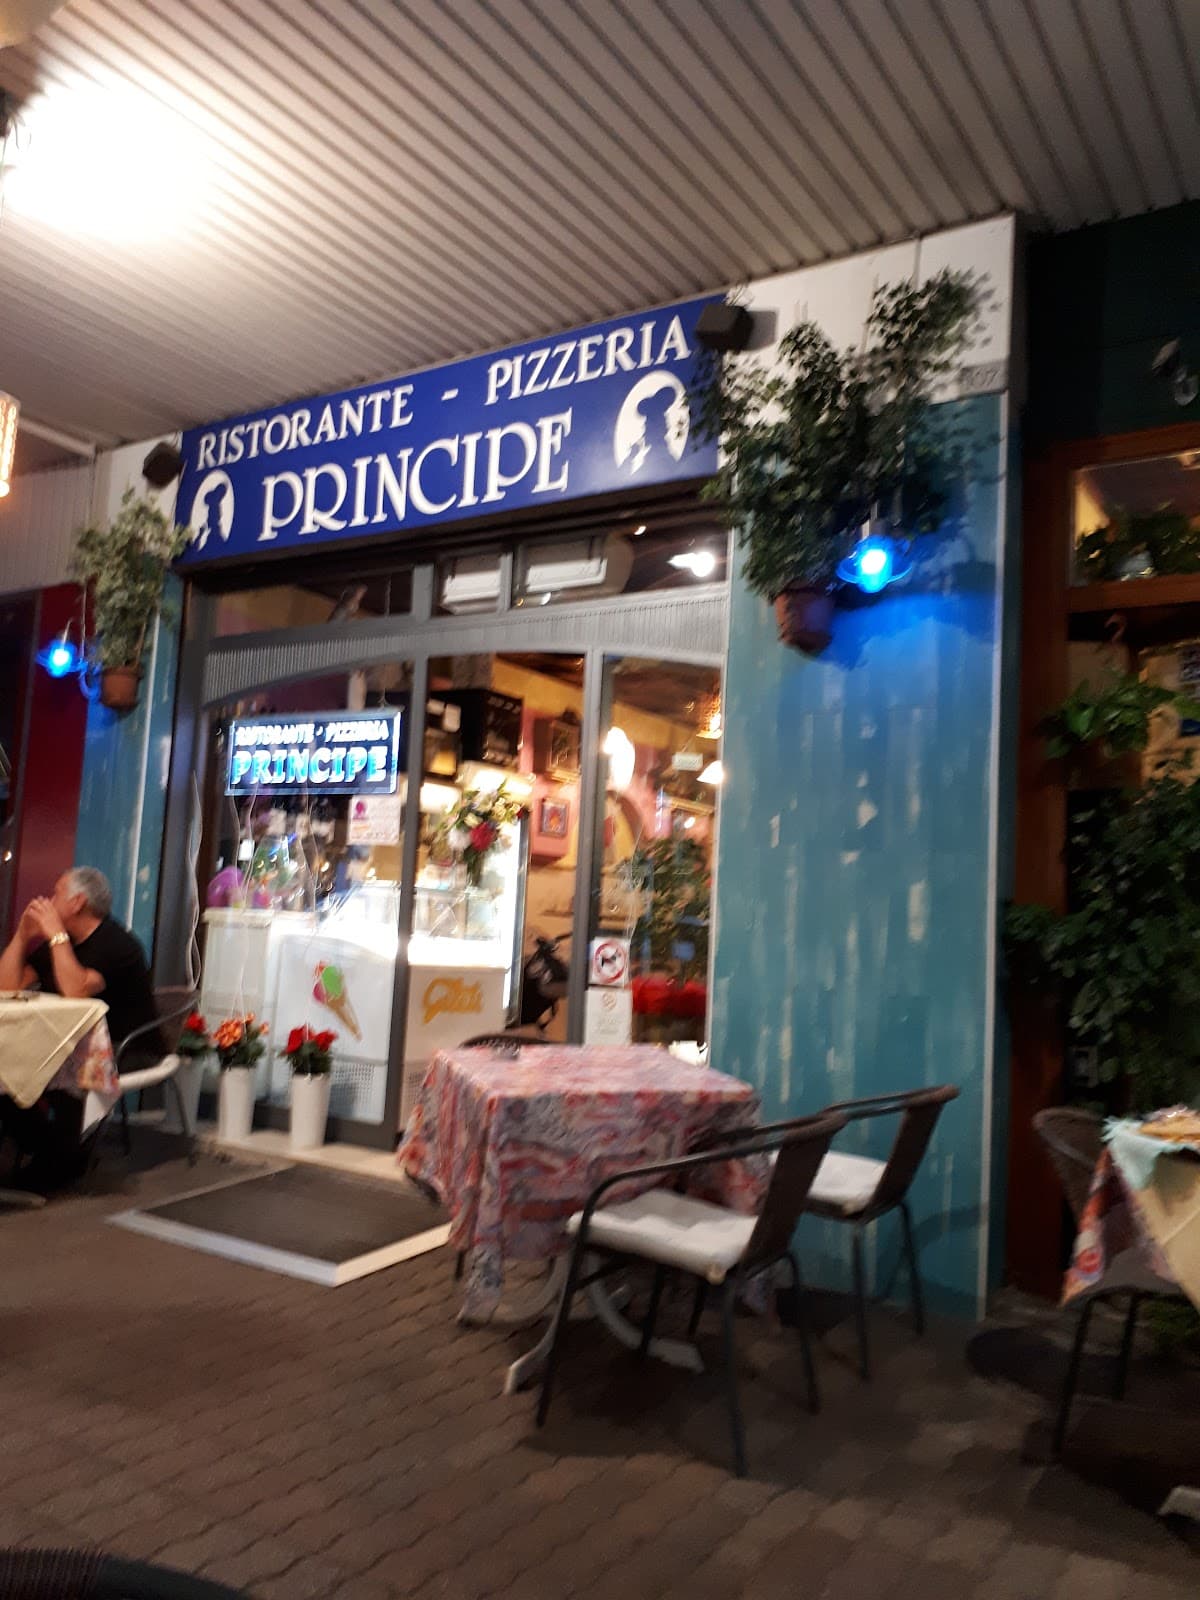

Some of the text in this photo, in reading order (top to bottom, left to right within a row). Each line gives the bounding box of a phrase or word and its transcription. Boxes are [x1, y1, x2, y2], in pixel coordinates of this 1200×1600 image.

[197, 385, 413, 471] RISTORANTE
[485, 316, 691, 404] PIZZERIA
[258, 409, 571, 541] PRINCIPE
[232, 746, 388, 784] PRINCIPE
